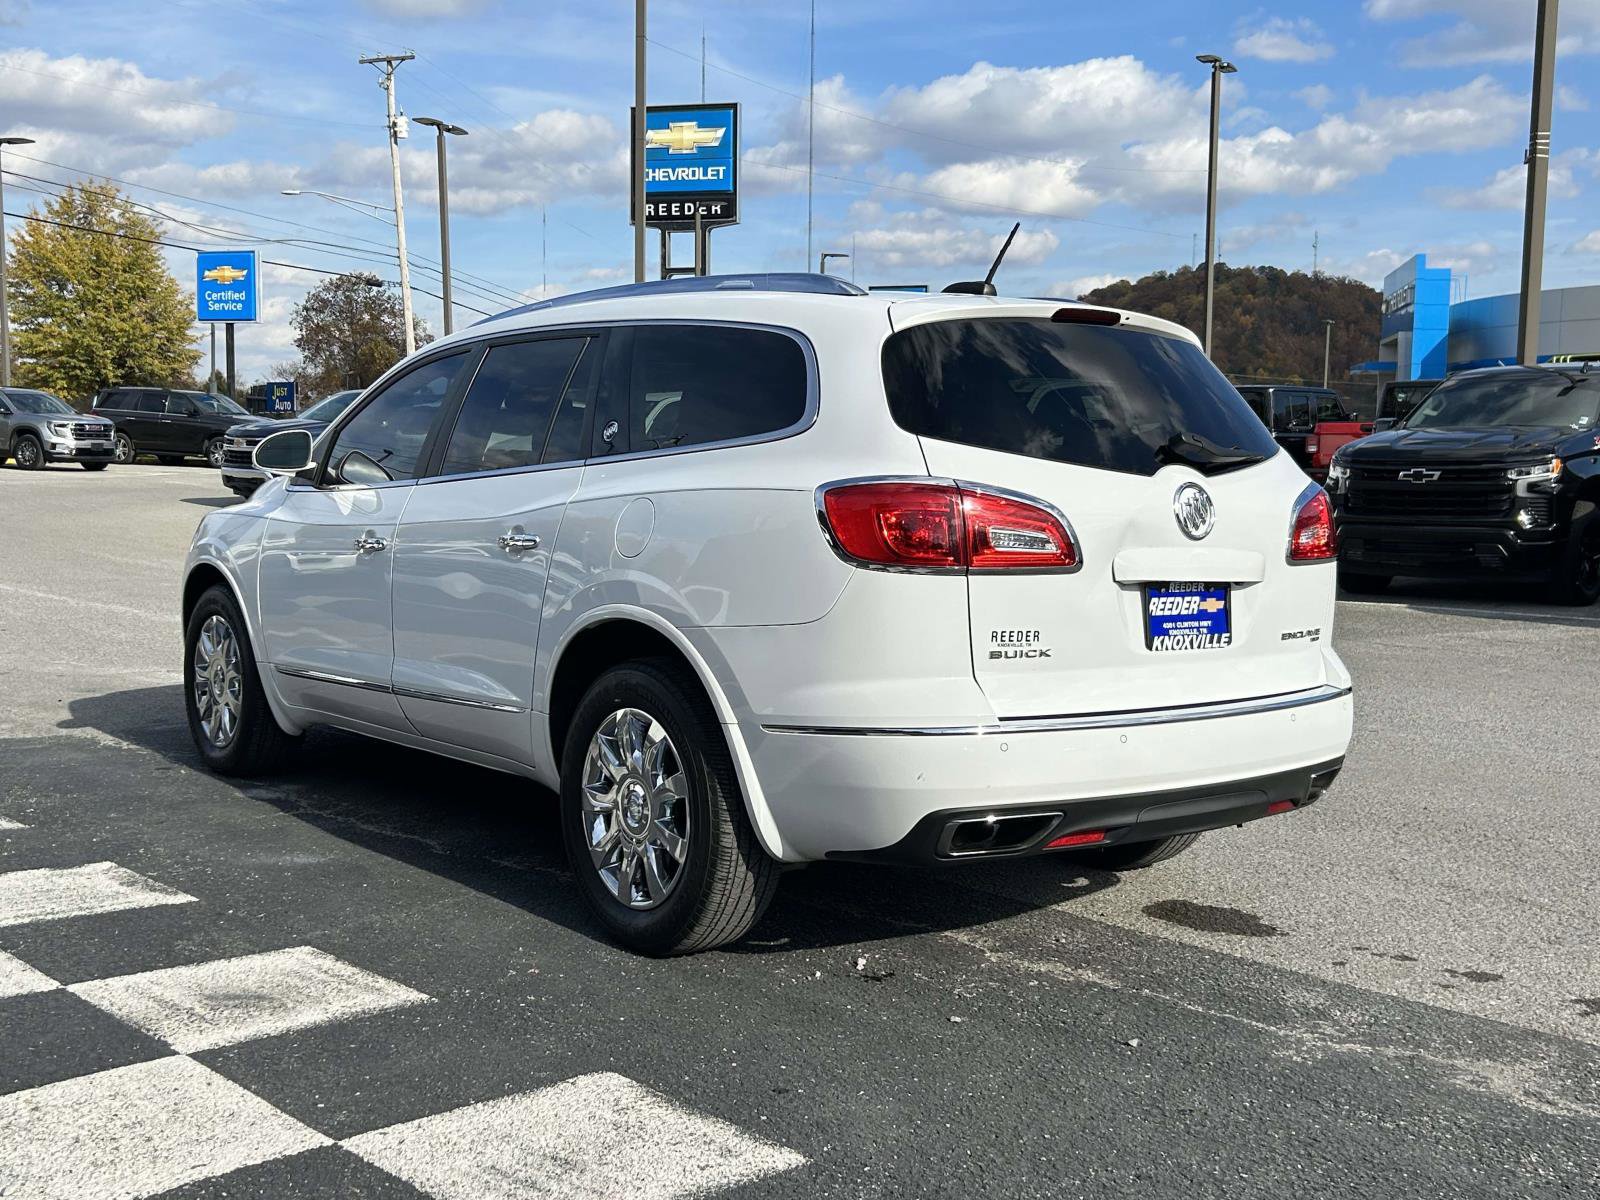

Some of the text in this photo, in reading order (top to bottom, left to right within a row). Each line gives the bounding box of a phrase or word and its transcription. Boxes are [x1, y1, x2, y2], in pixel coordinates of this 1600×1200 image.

[205, 290, 246, 301] Certified
[208, 301, 243, 311] Service
[1169, 583, 1205, 592] REEDER
[1149, 596, 1200, 616] REEDER
[991, 630, 1040, 642] REEDER
[1151, 633, 1230, 651] KNOXVILLE
[989, 649, 1052, 660] BUICK
